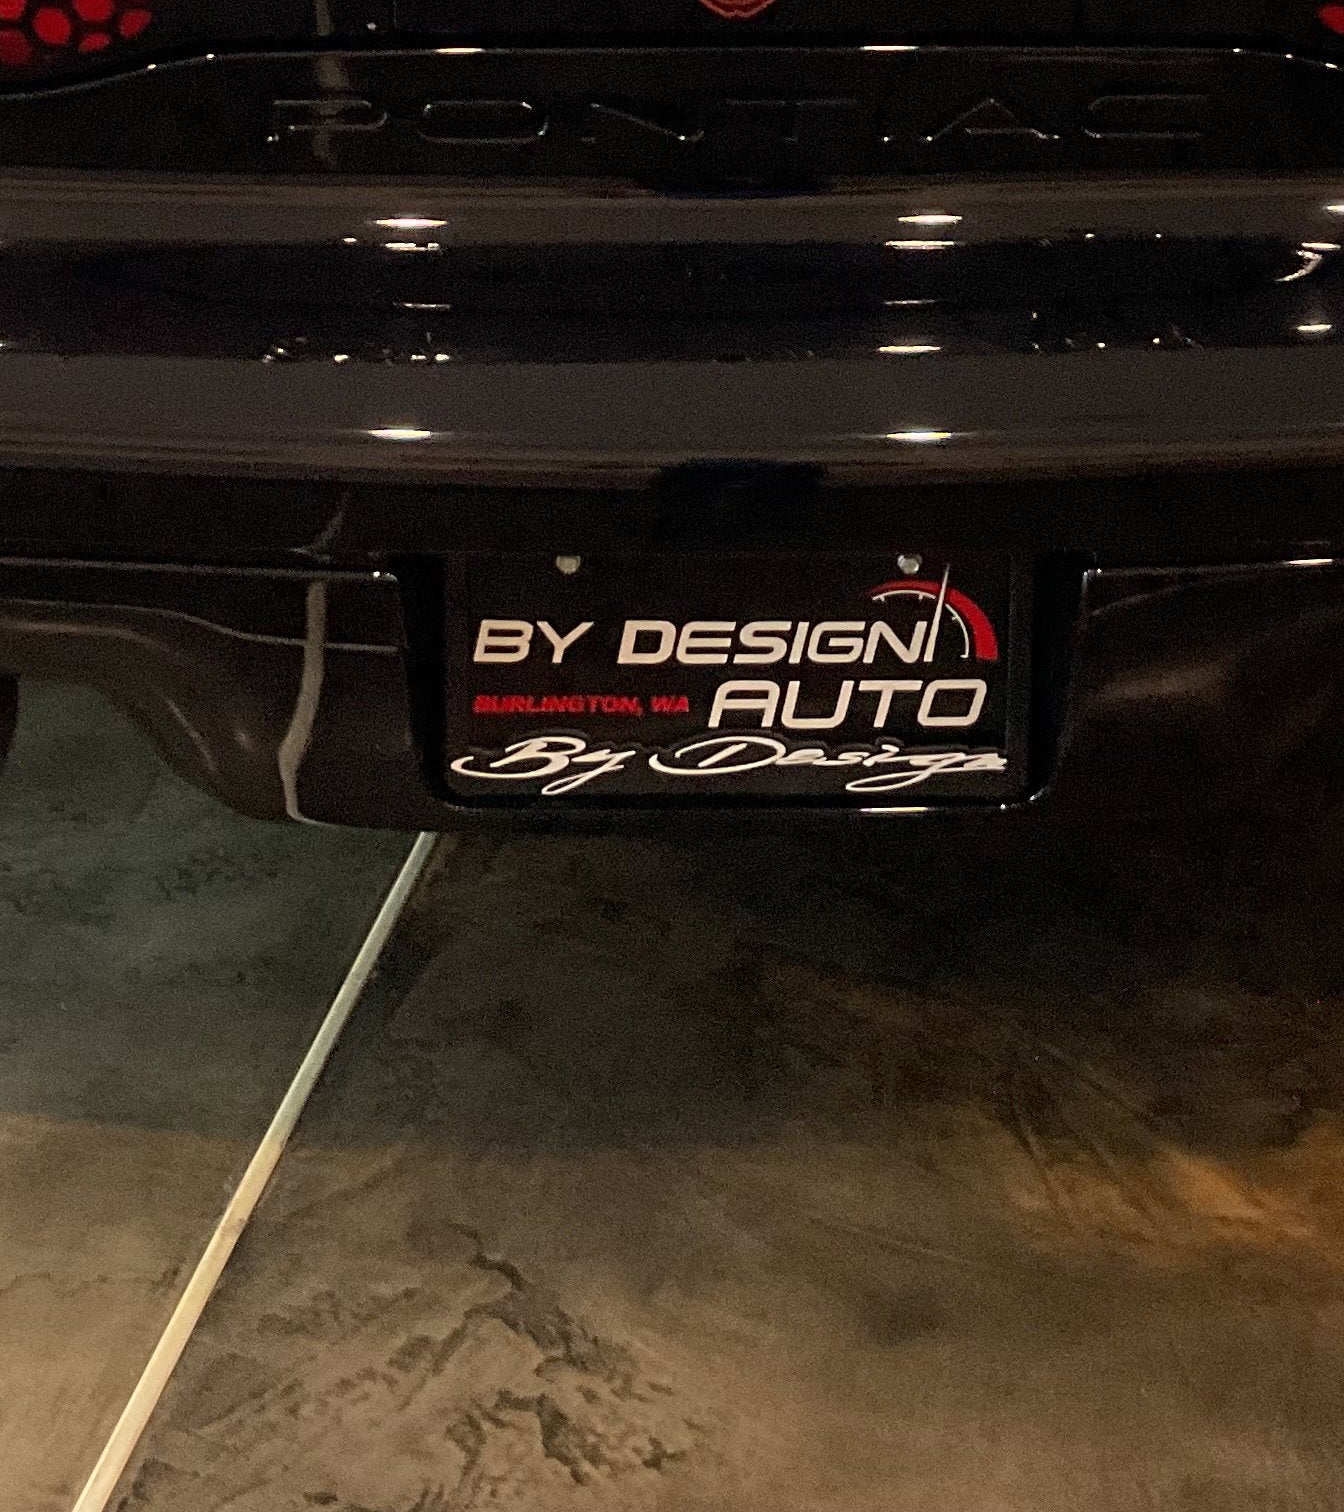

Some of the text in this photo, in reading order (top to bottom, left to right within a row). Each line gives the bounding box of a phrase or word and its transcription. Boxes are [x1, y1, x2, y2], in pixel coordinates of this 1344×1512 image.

[264, 92, 1206, 144] PONTIAC
[473, 620, 929, 664] BY DESIGN
[473, 694, 690, 717] BURLINGTON, WA
[708, 679, 988, 729] AUTO
[450, 736, 637, 796] By
